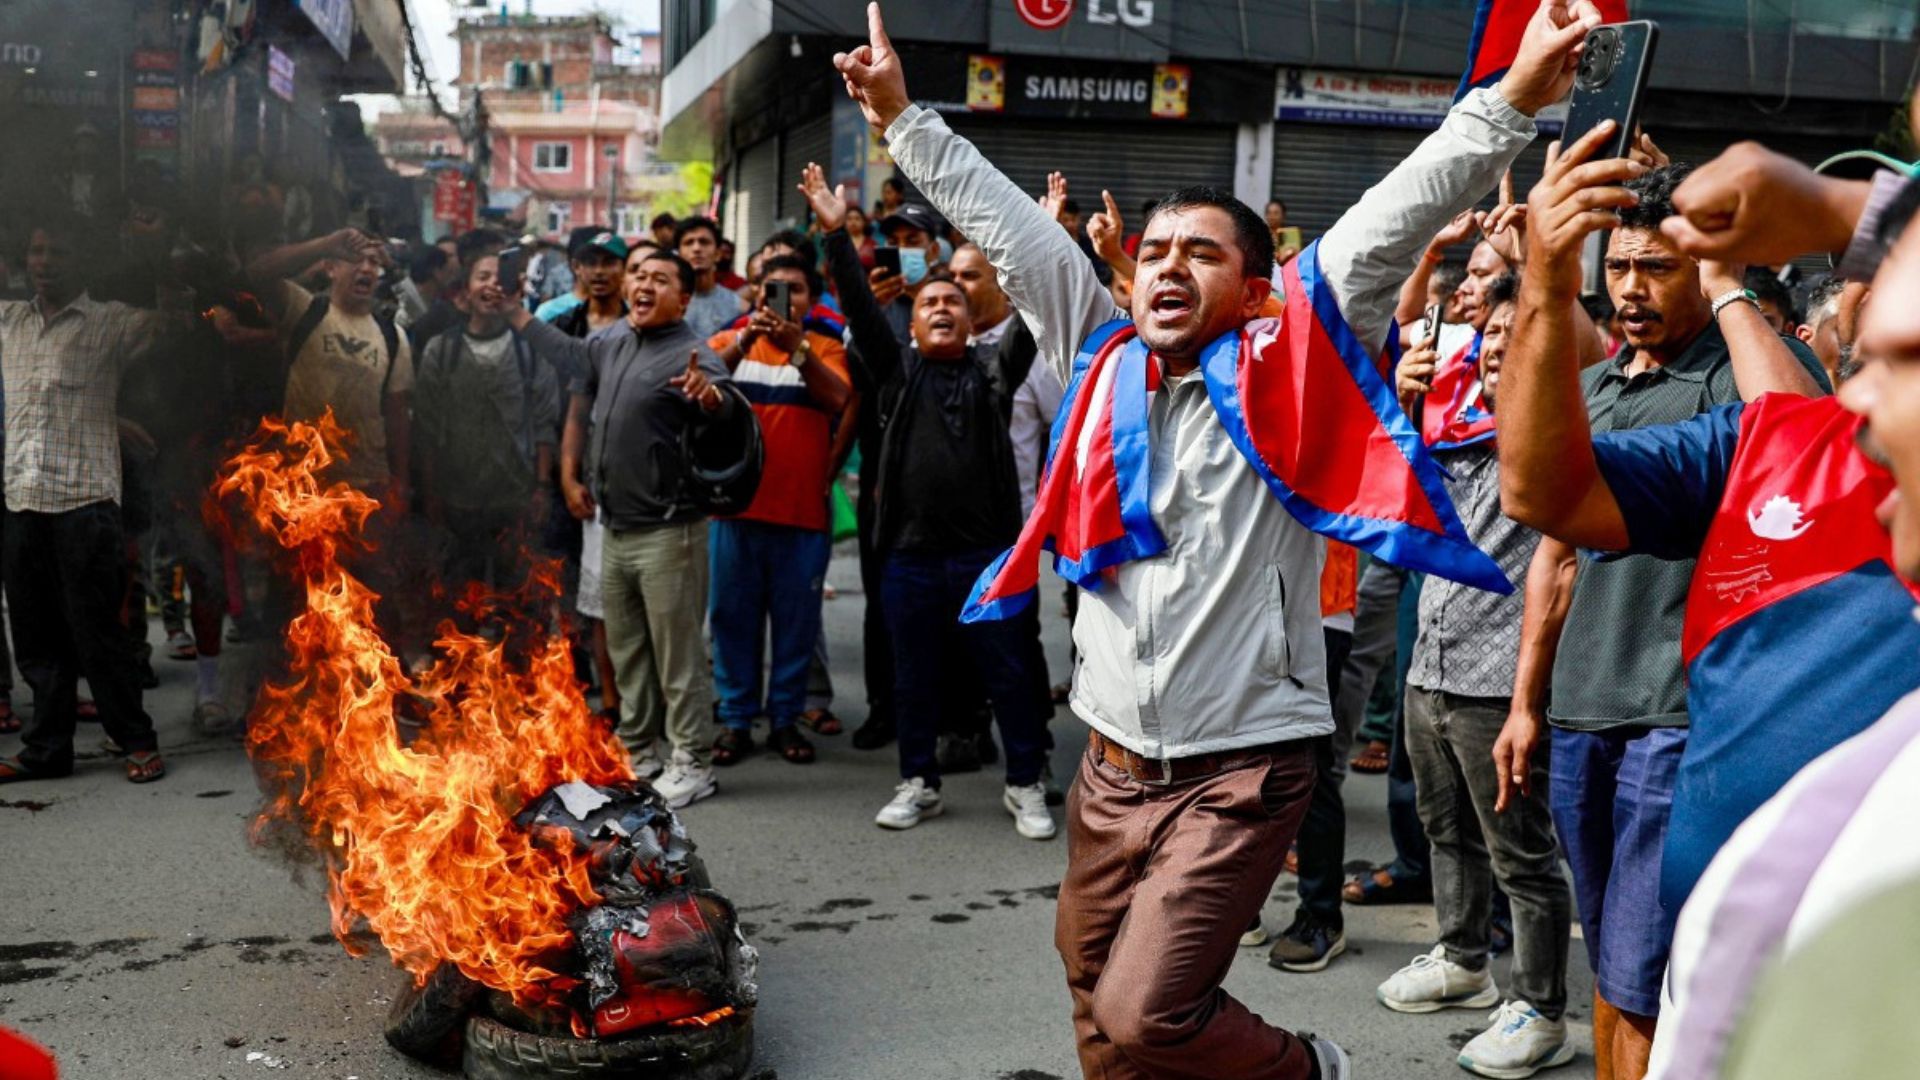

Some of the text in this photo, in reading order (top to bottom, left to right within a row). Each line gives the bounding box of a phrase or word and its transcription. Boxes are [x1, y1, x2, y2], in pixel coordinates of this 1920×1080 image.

[1087, 0, 1154, 26] LG
[1025, 75, 1148, 102] SAMSUNG
[1313, 72, 1326, 91] A
[323, 334, 337, 352] E
